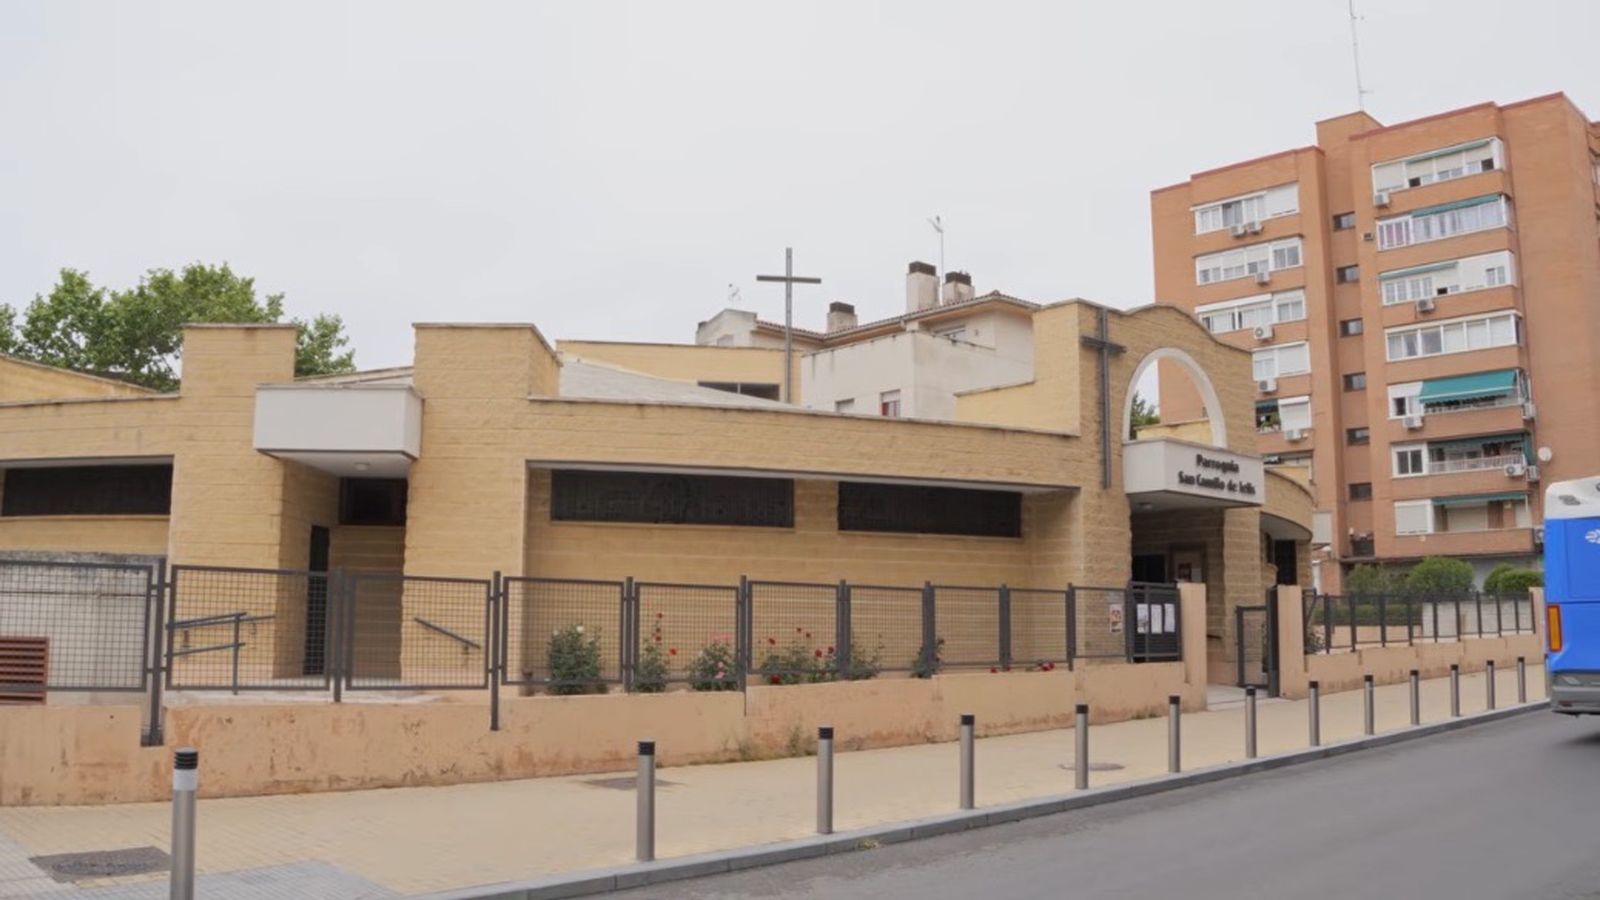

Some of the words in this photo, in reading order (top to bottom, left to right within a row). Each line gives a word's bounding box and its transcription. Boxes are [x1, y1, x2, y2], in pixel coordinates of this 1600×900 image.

[1196, 453, 1240, 475] Parroquia
[1178, 470, 1195, 486] San
[1227, 479, 1238, 493] de
